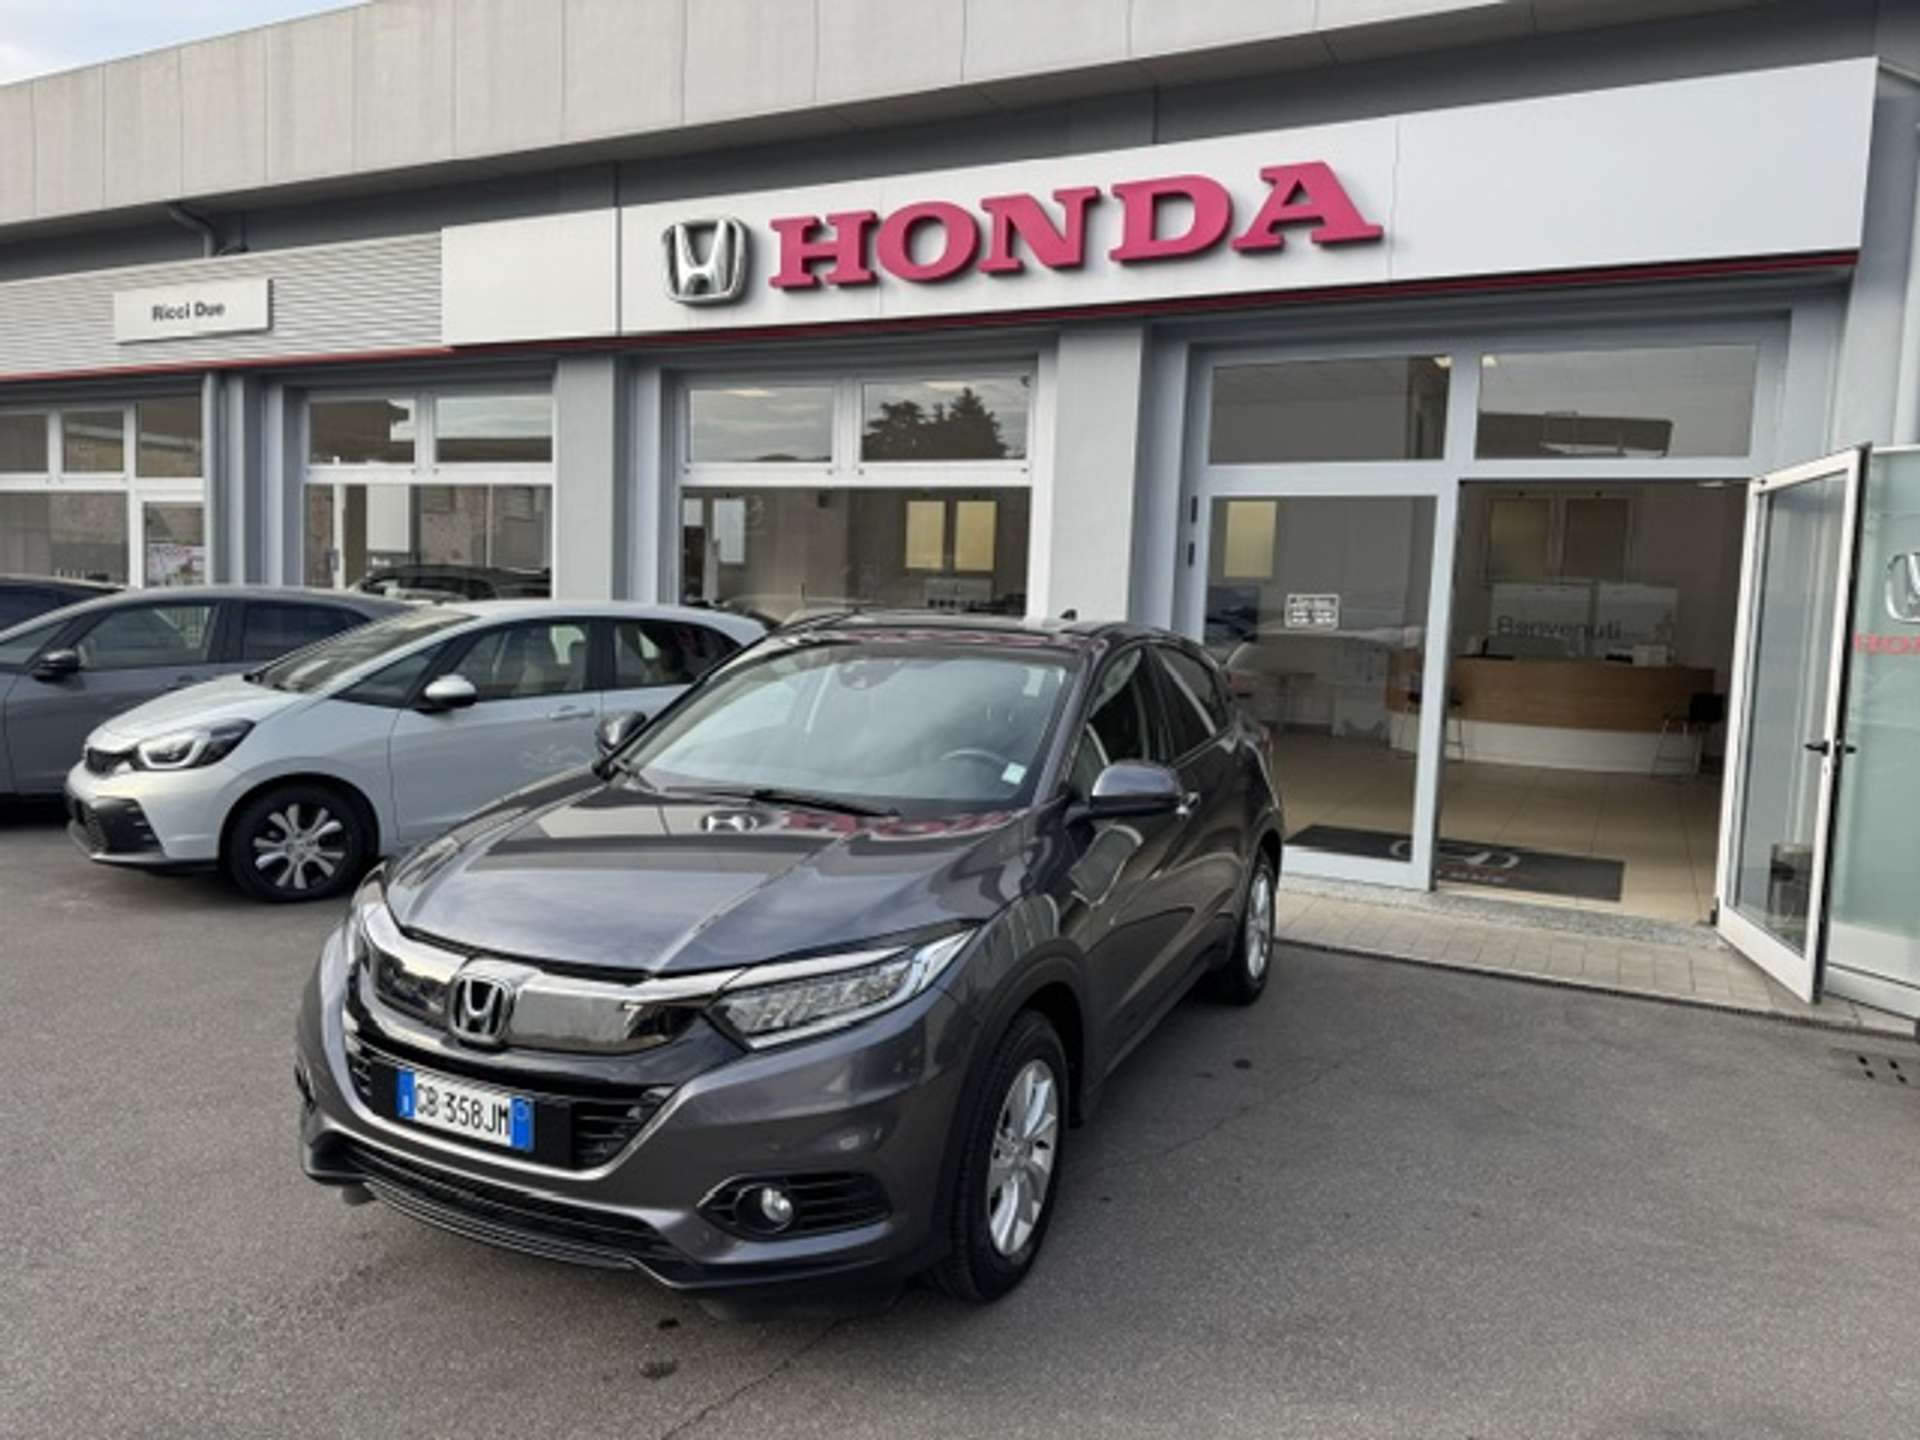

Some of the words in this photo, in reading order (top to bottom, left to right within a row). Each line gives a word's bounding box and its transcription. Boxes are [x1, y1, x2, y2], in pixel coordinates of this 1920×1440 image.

[768, 160, 1383, 289] HONDA
[152, 302, 190, 321] Ricci
[194, 301, 225, 317] Due
[1854, 632, 1920, 655] HO
